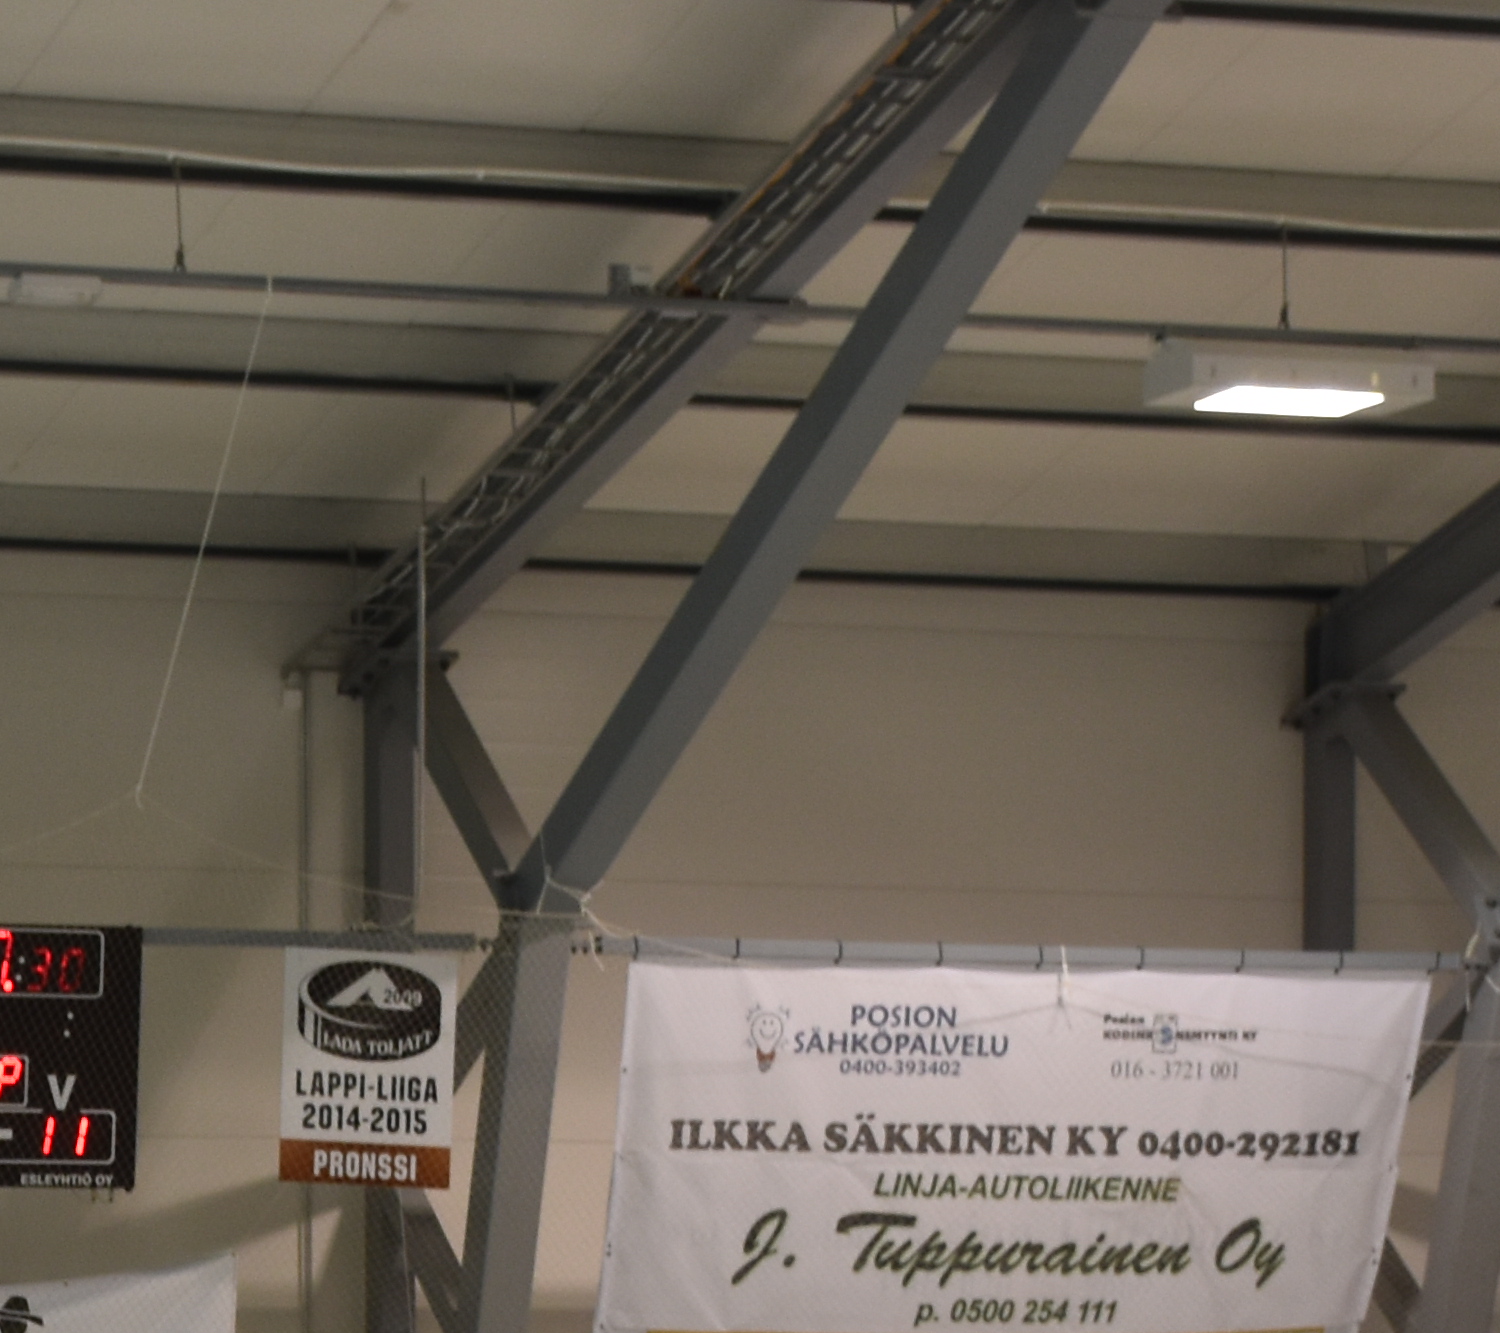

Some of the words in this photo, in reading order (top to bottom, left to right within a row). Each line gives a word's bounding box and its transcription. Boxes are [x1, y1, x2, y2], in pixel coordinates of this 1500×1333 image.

[850, 1004, 957, 1028] POSION
[792, 1023, 1009, 1059] SÄHKÖPALVELU
[839, 1058, 962, 1078] 0400-393402
[1111, 1061, 1144, 1079] 016
[1162, 1061, 1203, 1080] 3721
[1210, 1061, 1239, 1079] 001
[46, 1073, 78, 1112] V
[295, 1070, 439, 1104] LAPPI-LIIGA
[302, 1103, 428, 1135] 2014-2015
[668, 1119, 811, 1153] ILKKA
[823, 1113, 1054, 1158] SÄKKINEN
[1065, 1124, 1129, 1158] KY
[1138, 1127, 1362, 1160] 0400-292181
[312, 1149, 418, 1182] PRONSSI
[873, 1170, 1181, 1203] LINJA-AUTOLIIKENNE
[731, 1209, 797, 1287] J.
[836, 1212, 1192, 1290] Tuppurainen
[1215, 1217, 1286, 1288] Oy
[912, 1302, 941, 1328] p.
[949, 1300, 1013, 1325] 0500
[1021, 1299, 1070, 1324] 254
[1076, 1300, 1119, 1325] 111
